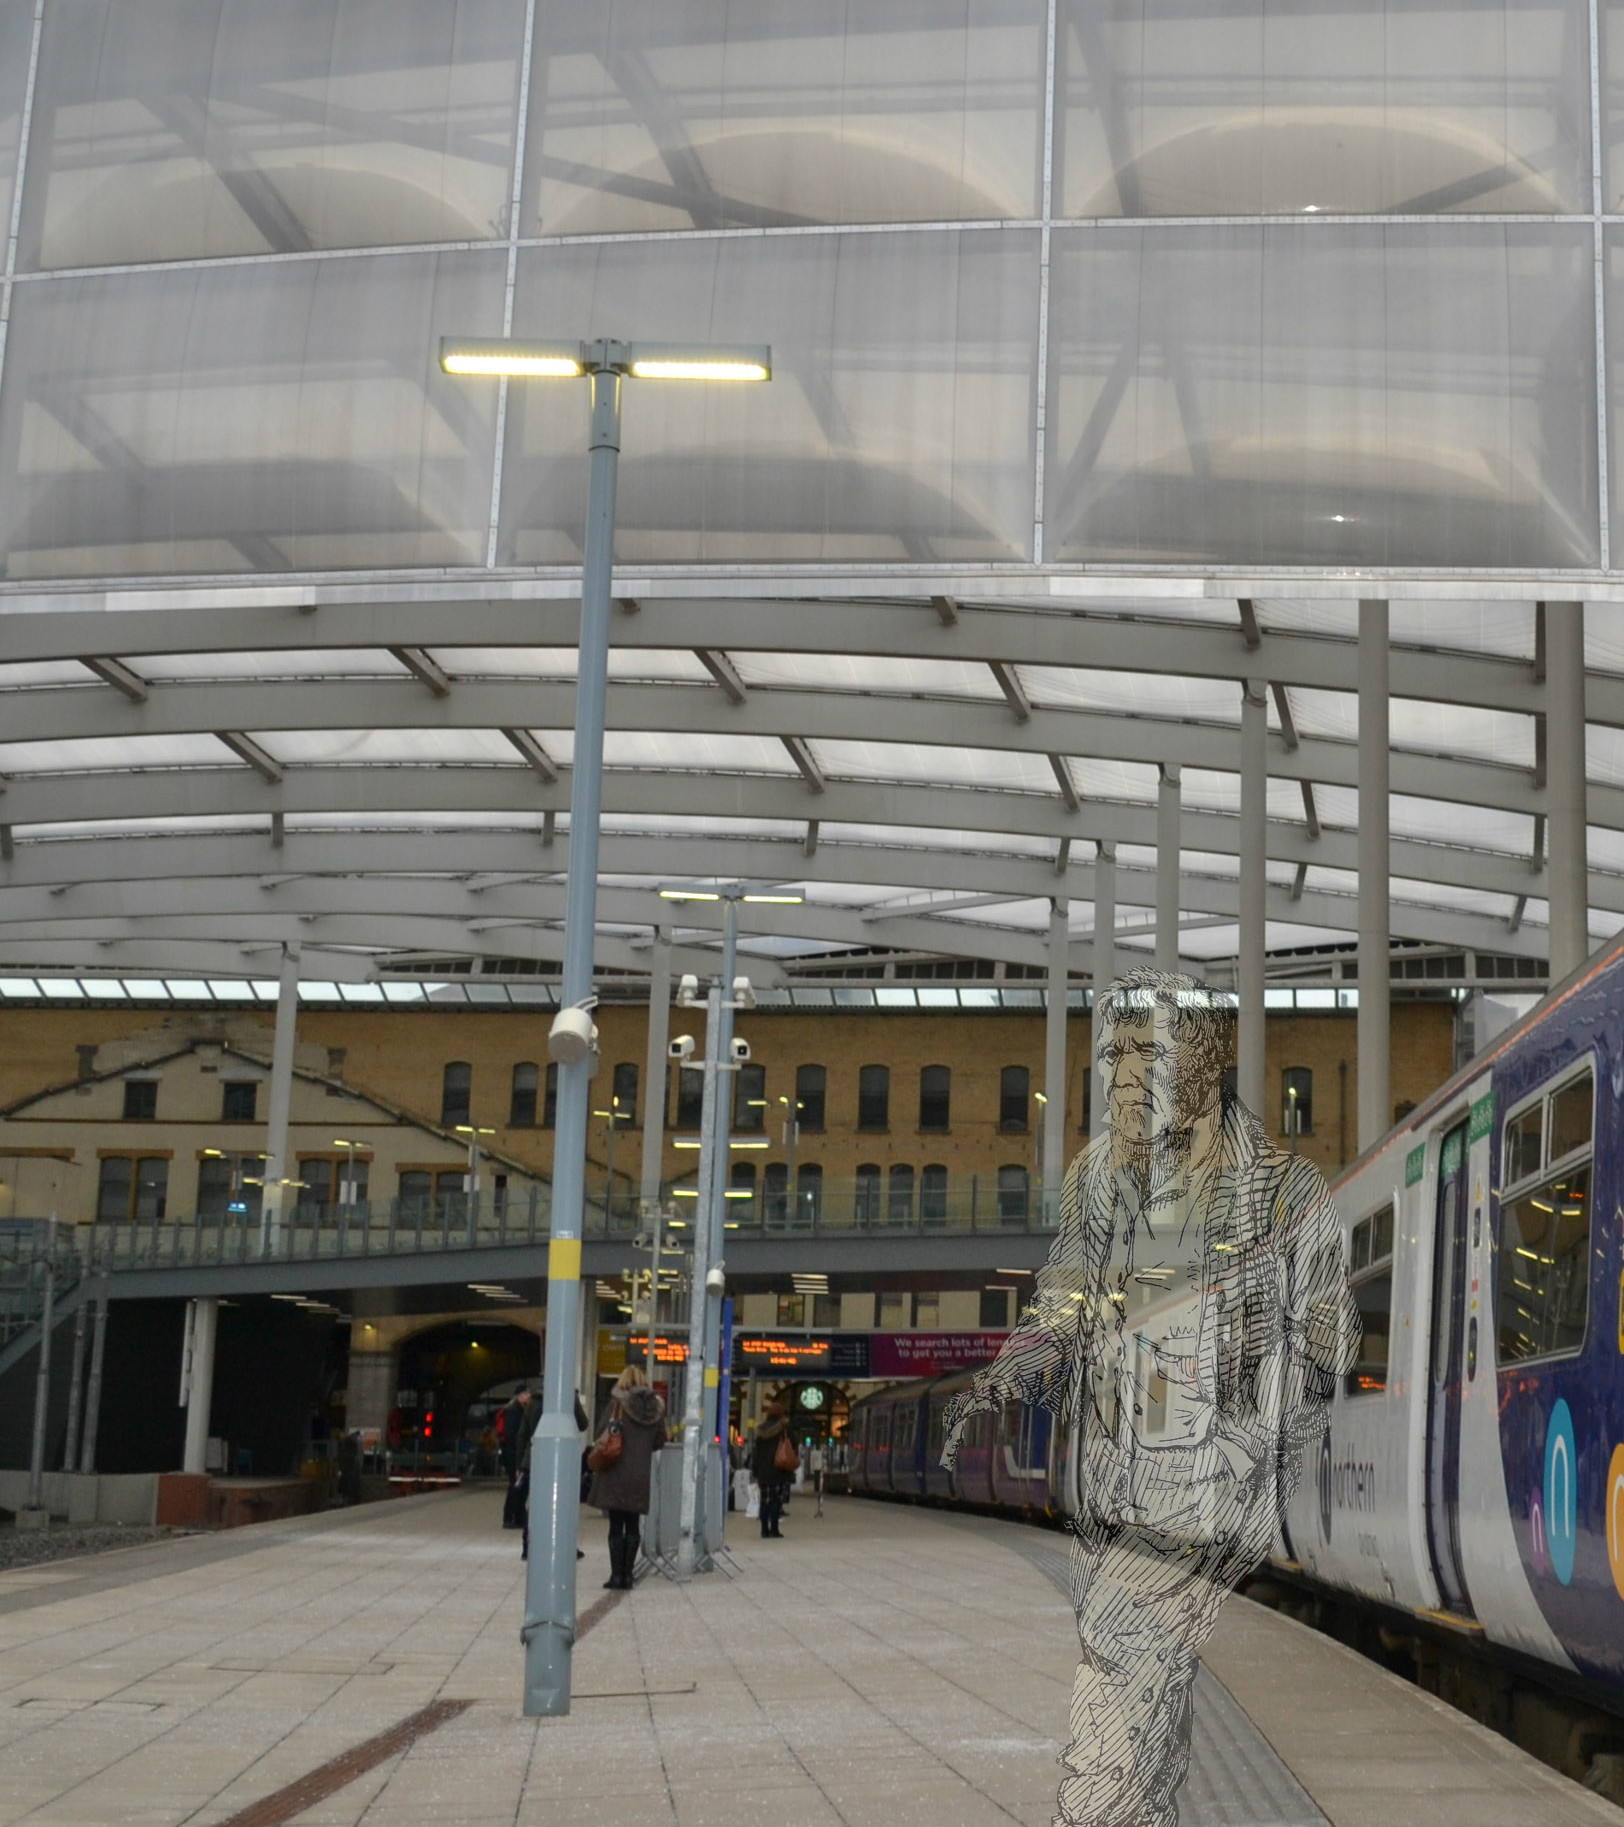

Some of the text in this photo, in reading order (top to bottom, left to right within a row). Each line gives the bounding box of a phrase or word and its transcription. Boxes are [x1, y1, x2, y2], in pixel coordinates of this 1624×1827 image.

[895, 1338, 911, 1347] We
[915, 1338, 949, 1347] search
[951, 1338, 971, 1347] lots
[973, 1338, 985, 1347] of
[899, 1348, 910, 1357] to
[912, 1348, 931, 1359] get
[933, 1350, 952, 1359] you
[964, 1348, 996, 1357] better
[1332, 1441, 1376, 1513] northern
